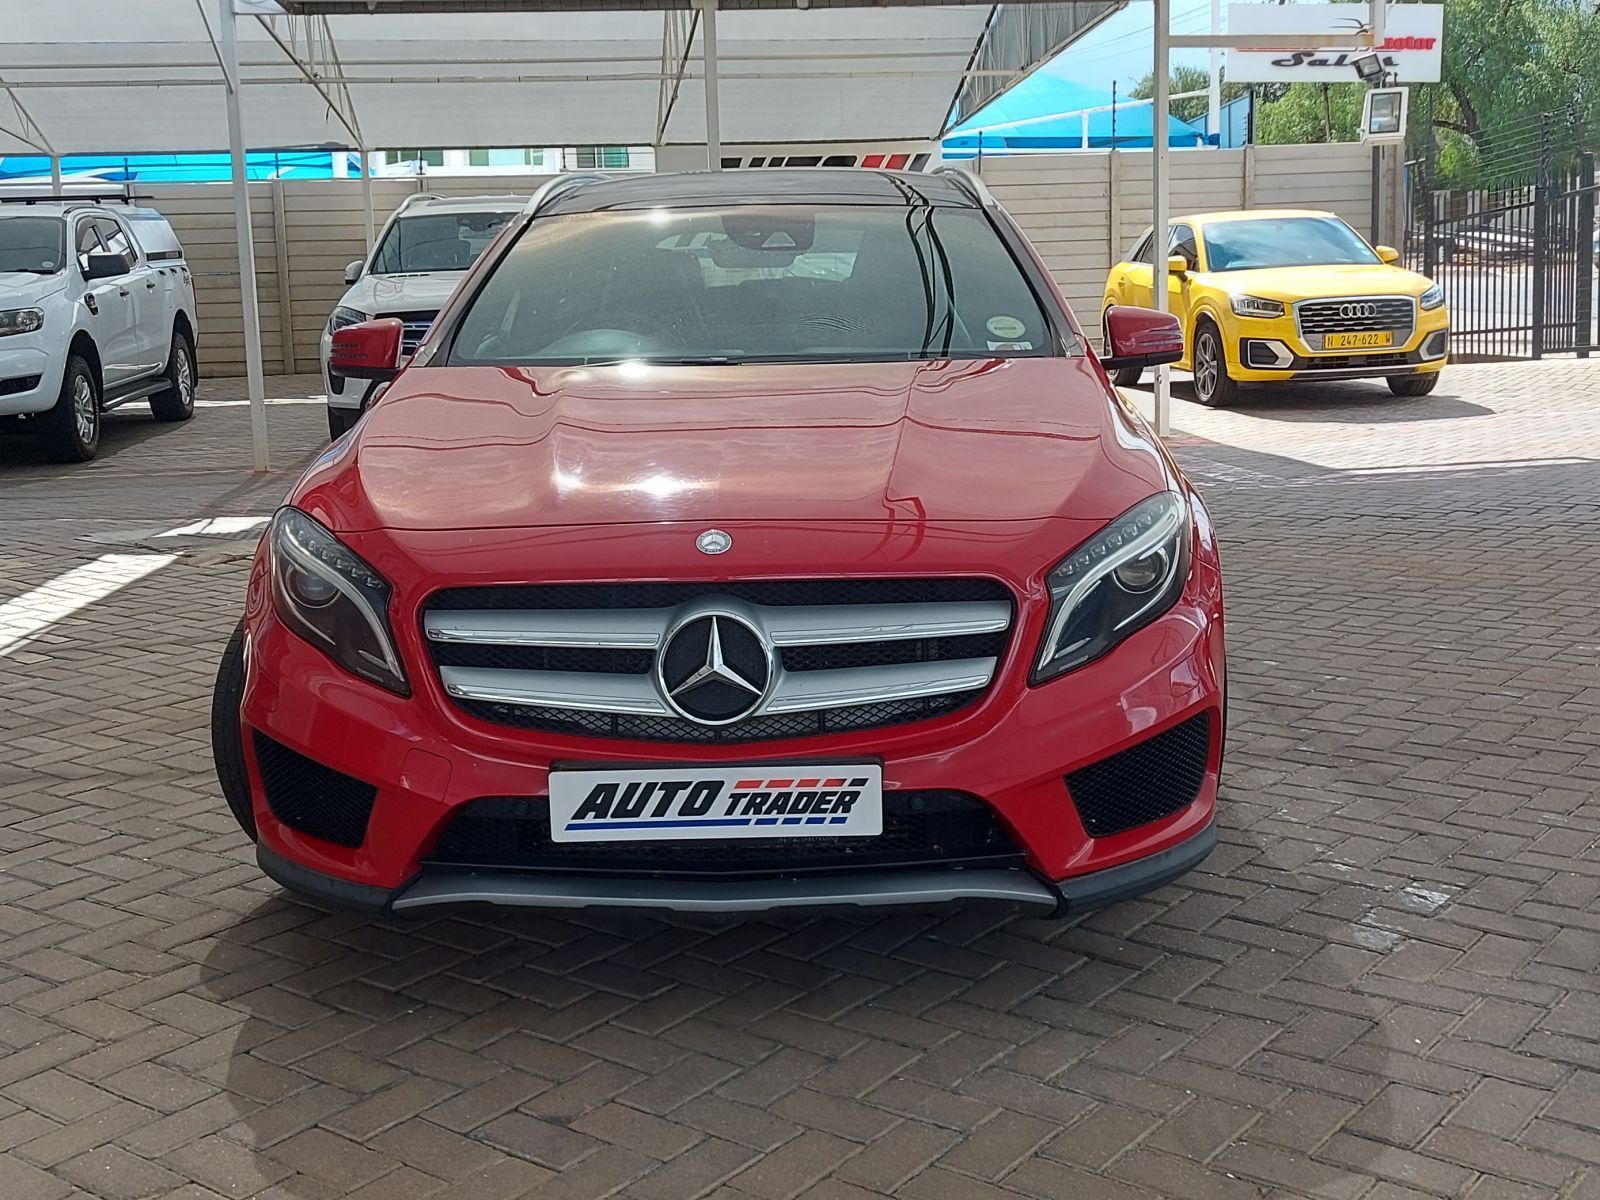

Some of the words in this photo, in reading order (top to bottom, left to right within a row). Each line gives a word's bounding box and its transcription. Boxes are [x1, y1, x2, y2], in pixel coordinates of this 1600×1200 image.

[1270, 52, 1400, 67] Sals
[1327, 335, 1334, 347] N
[1340, 333, 1379, 346] 247-622
[570, 780, 725, 821] AUTO
[723, 790, 862, 816] TRADER
